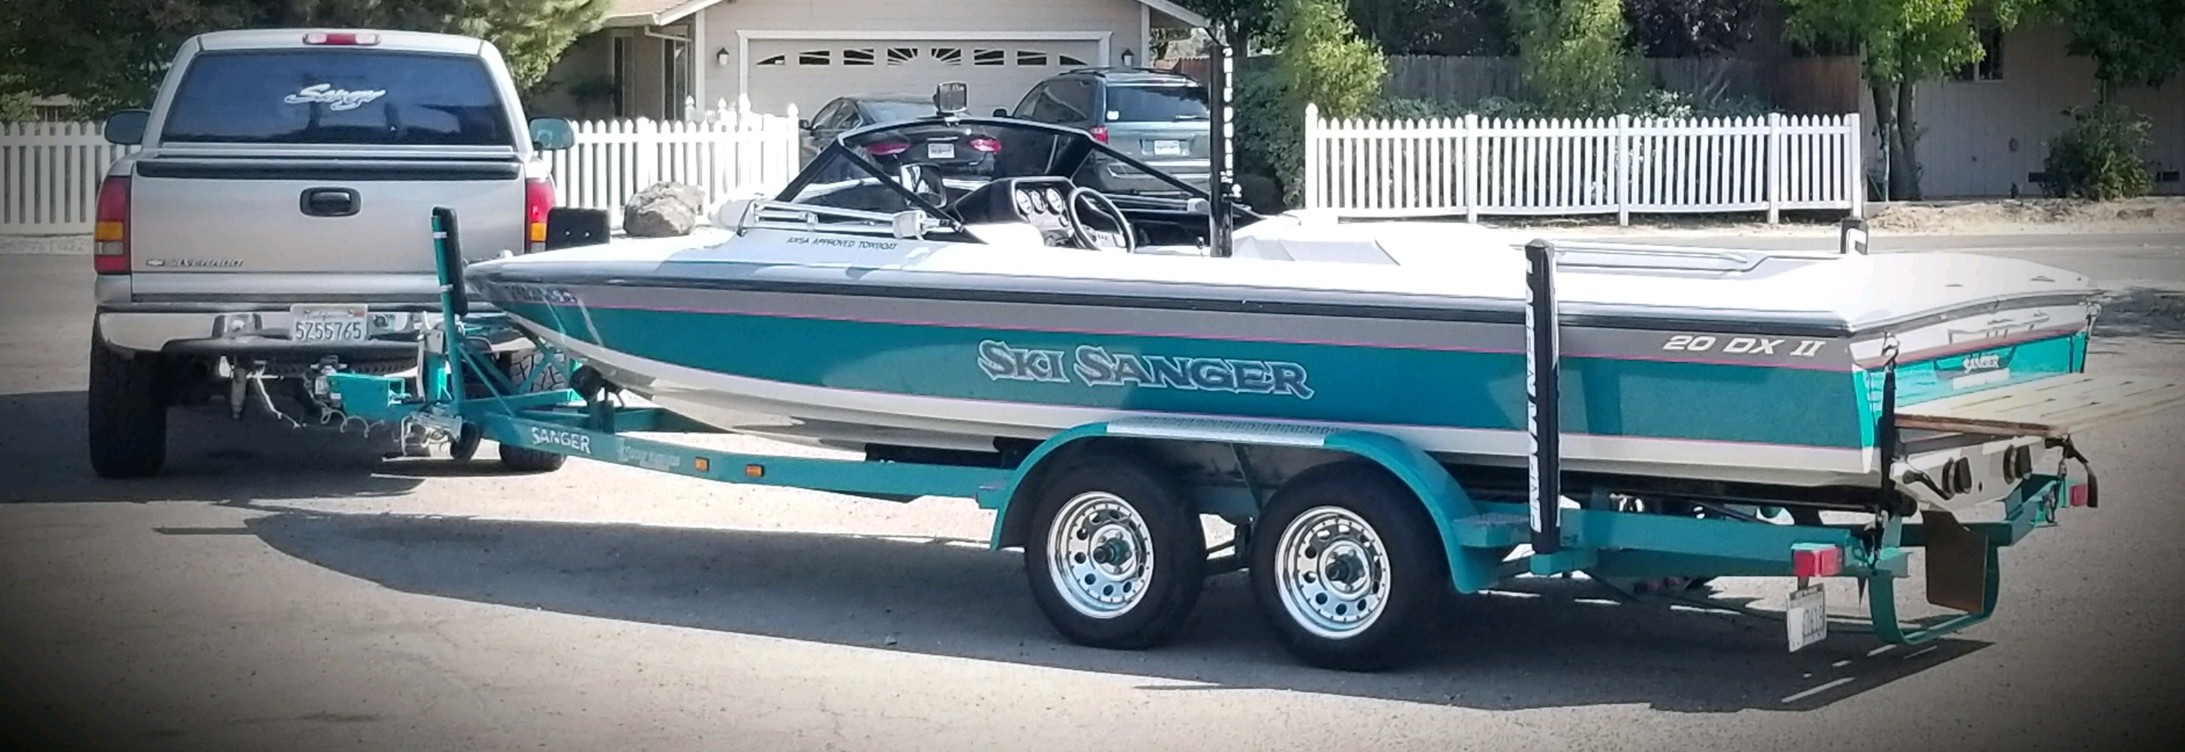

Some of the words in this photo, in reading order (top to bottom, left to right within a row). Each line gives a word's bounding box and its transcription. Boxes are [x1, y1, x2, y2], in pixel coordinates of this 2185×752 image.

[812, 237, 855, 248] APPROVED
[1662, 335, 1717, 351] 20
[1722, 337, 1785, 354] DX
[1789, 340, 1827, 356] II
[531, 426, 591, 454] SANGER
